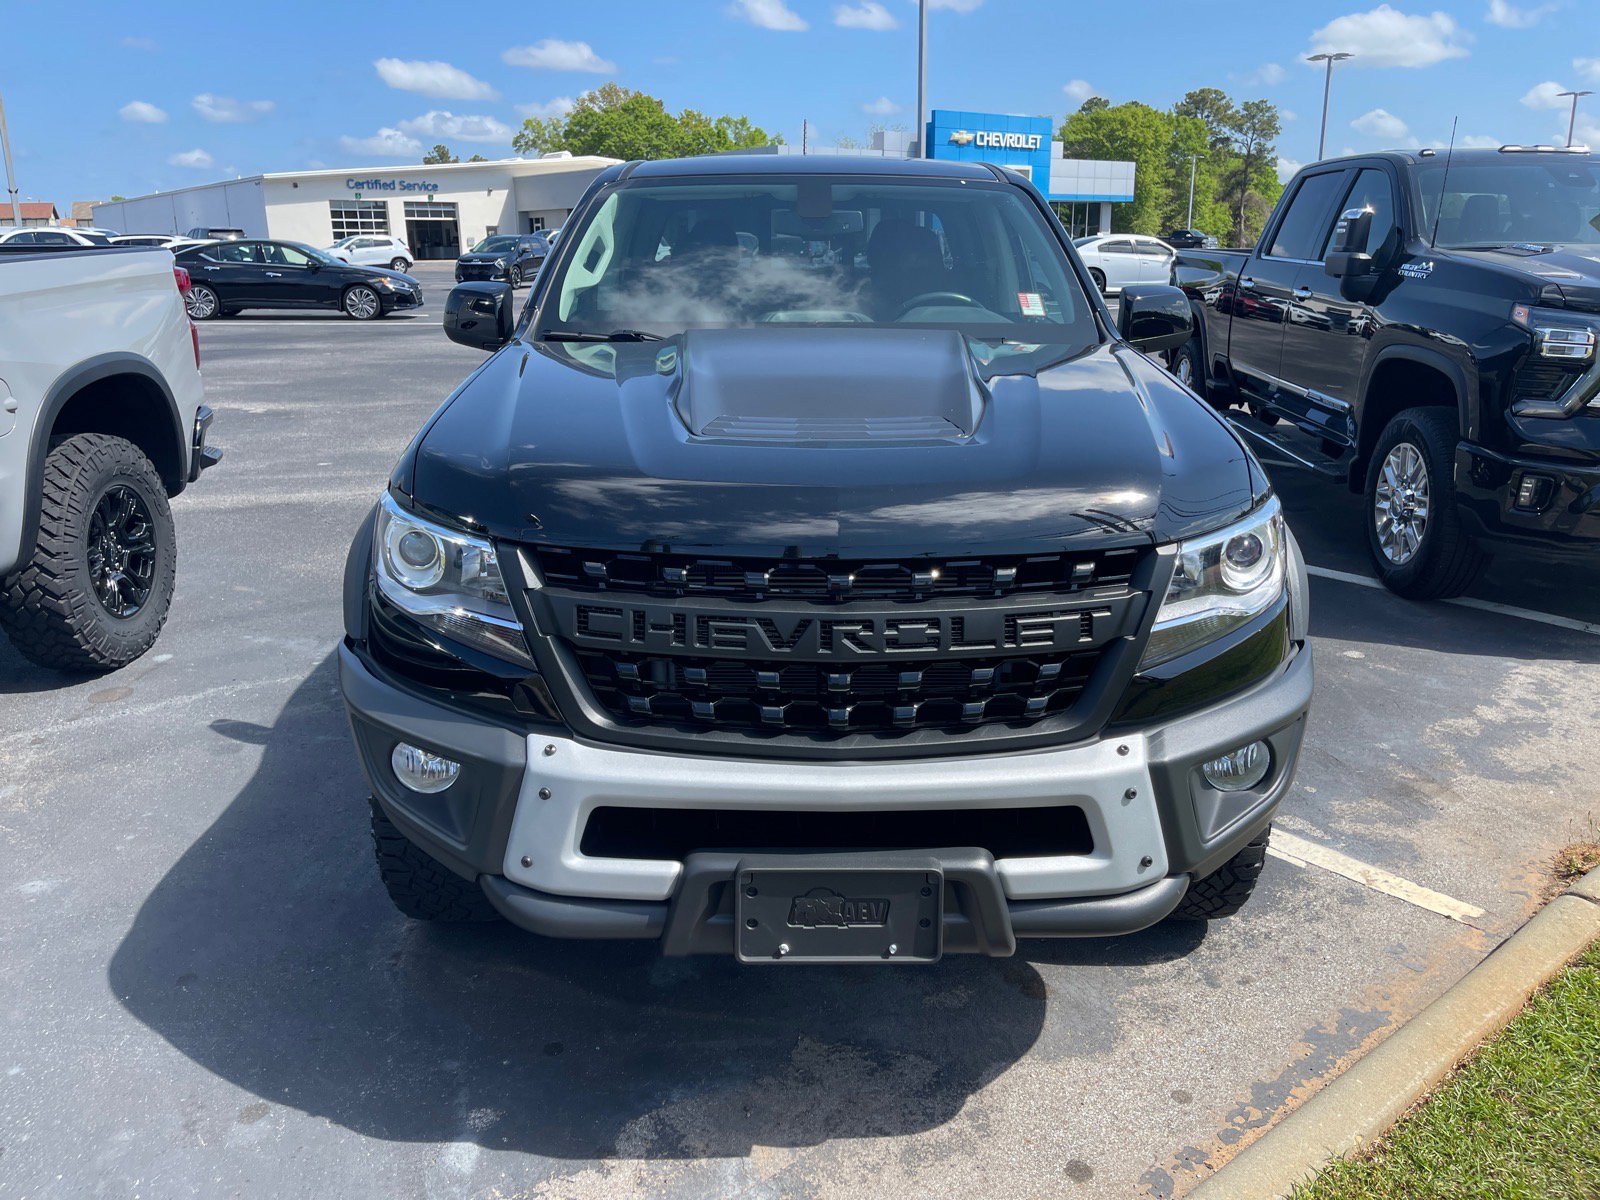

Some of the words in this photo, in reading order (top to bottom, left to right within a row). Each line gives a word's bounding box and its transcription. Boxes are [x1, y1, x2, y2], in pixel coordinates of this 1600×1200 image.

[976, 131, 1042, 149] CHEVROLET
[346, 178, 395, 190] Certified
[399, 180, 438, 191] Service
[576, 604, 1112, 654] CHEVROLET
[844, 902, 885, 921] AEV
